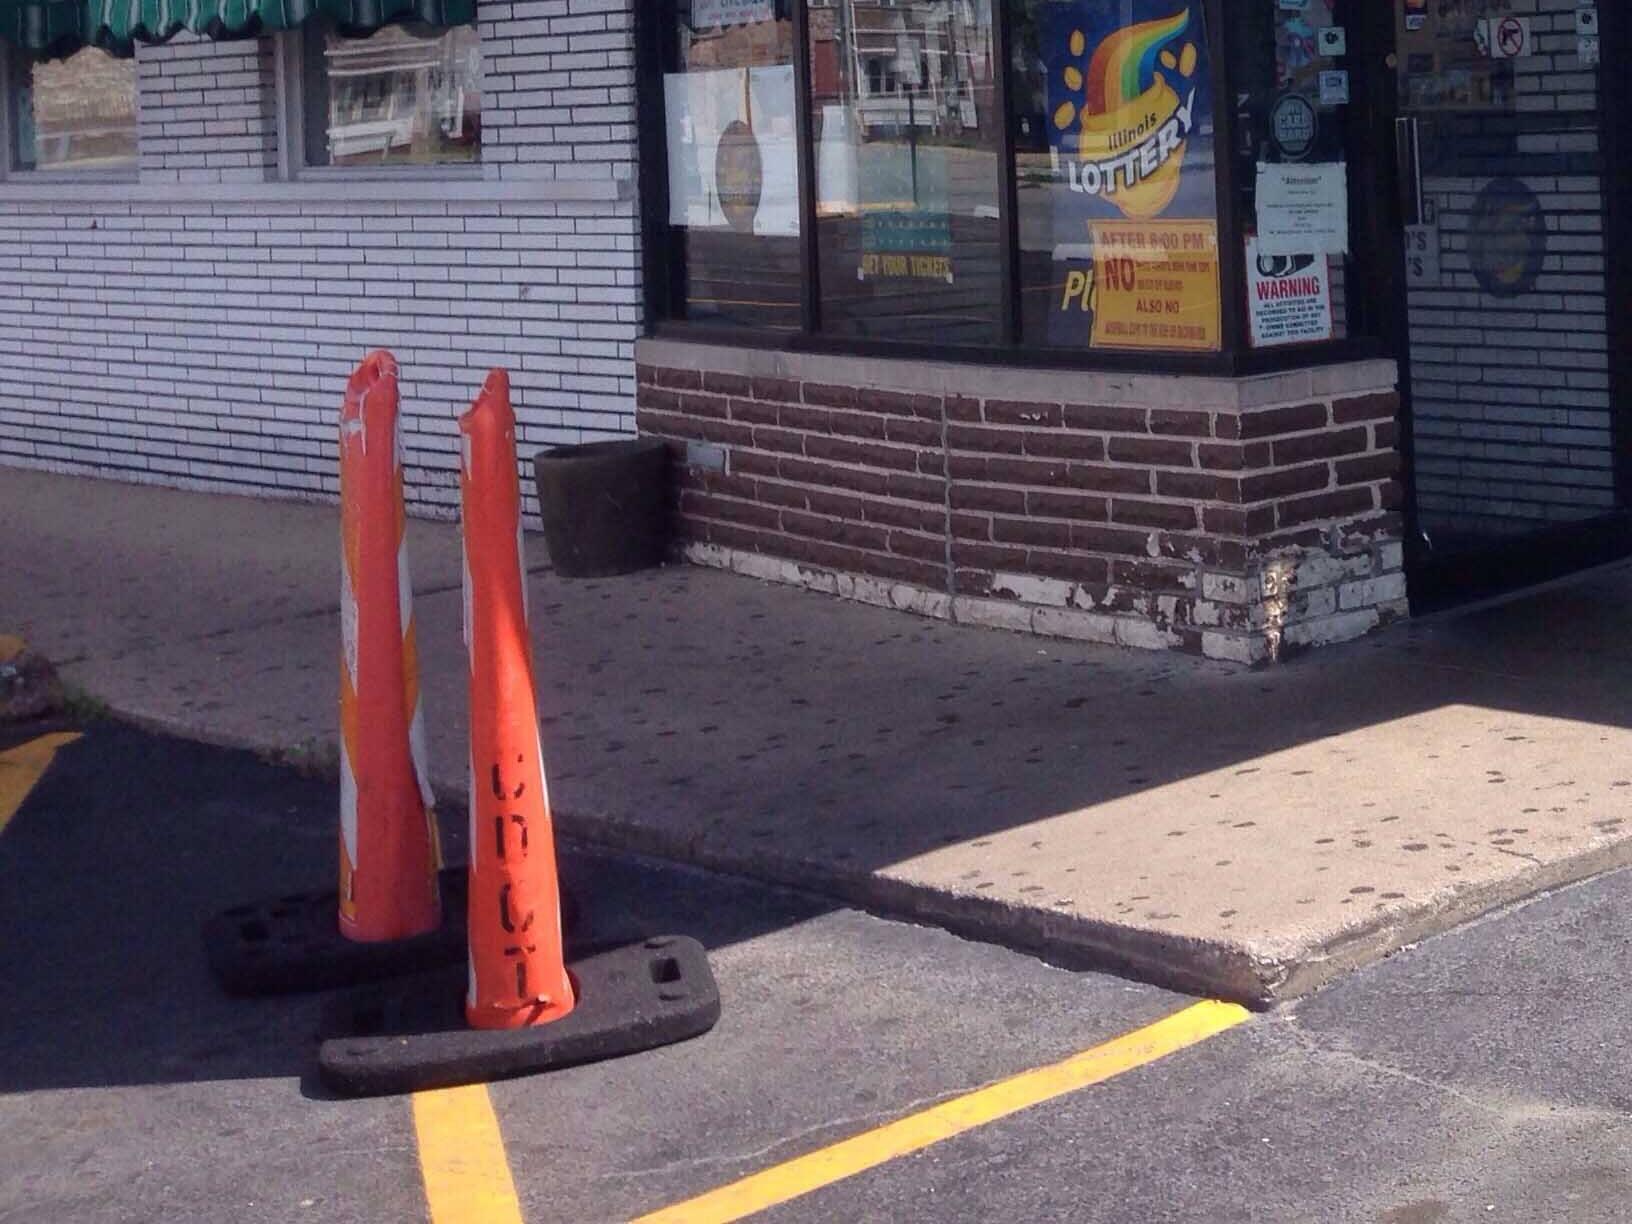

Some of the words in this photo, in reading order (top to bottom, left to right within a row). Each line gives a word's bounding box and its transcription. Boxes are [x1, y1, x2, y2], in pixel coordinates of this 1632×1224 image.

[1068, 87, 1197, 196] LOTTERY
[1108, 111, 1157, 152] Illinois
[1101, 231, 1145, 249] AFTER
[1183, 232, 1204, 249] PM
[1104, 256, 1136, 292] NO
[1256, 276, 1320, 300] WARNING
[1136, 299, 1162, 314] ALSO
[1165, 299, 1180, 314] NO
